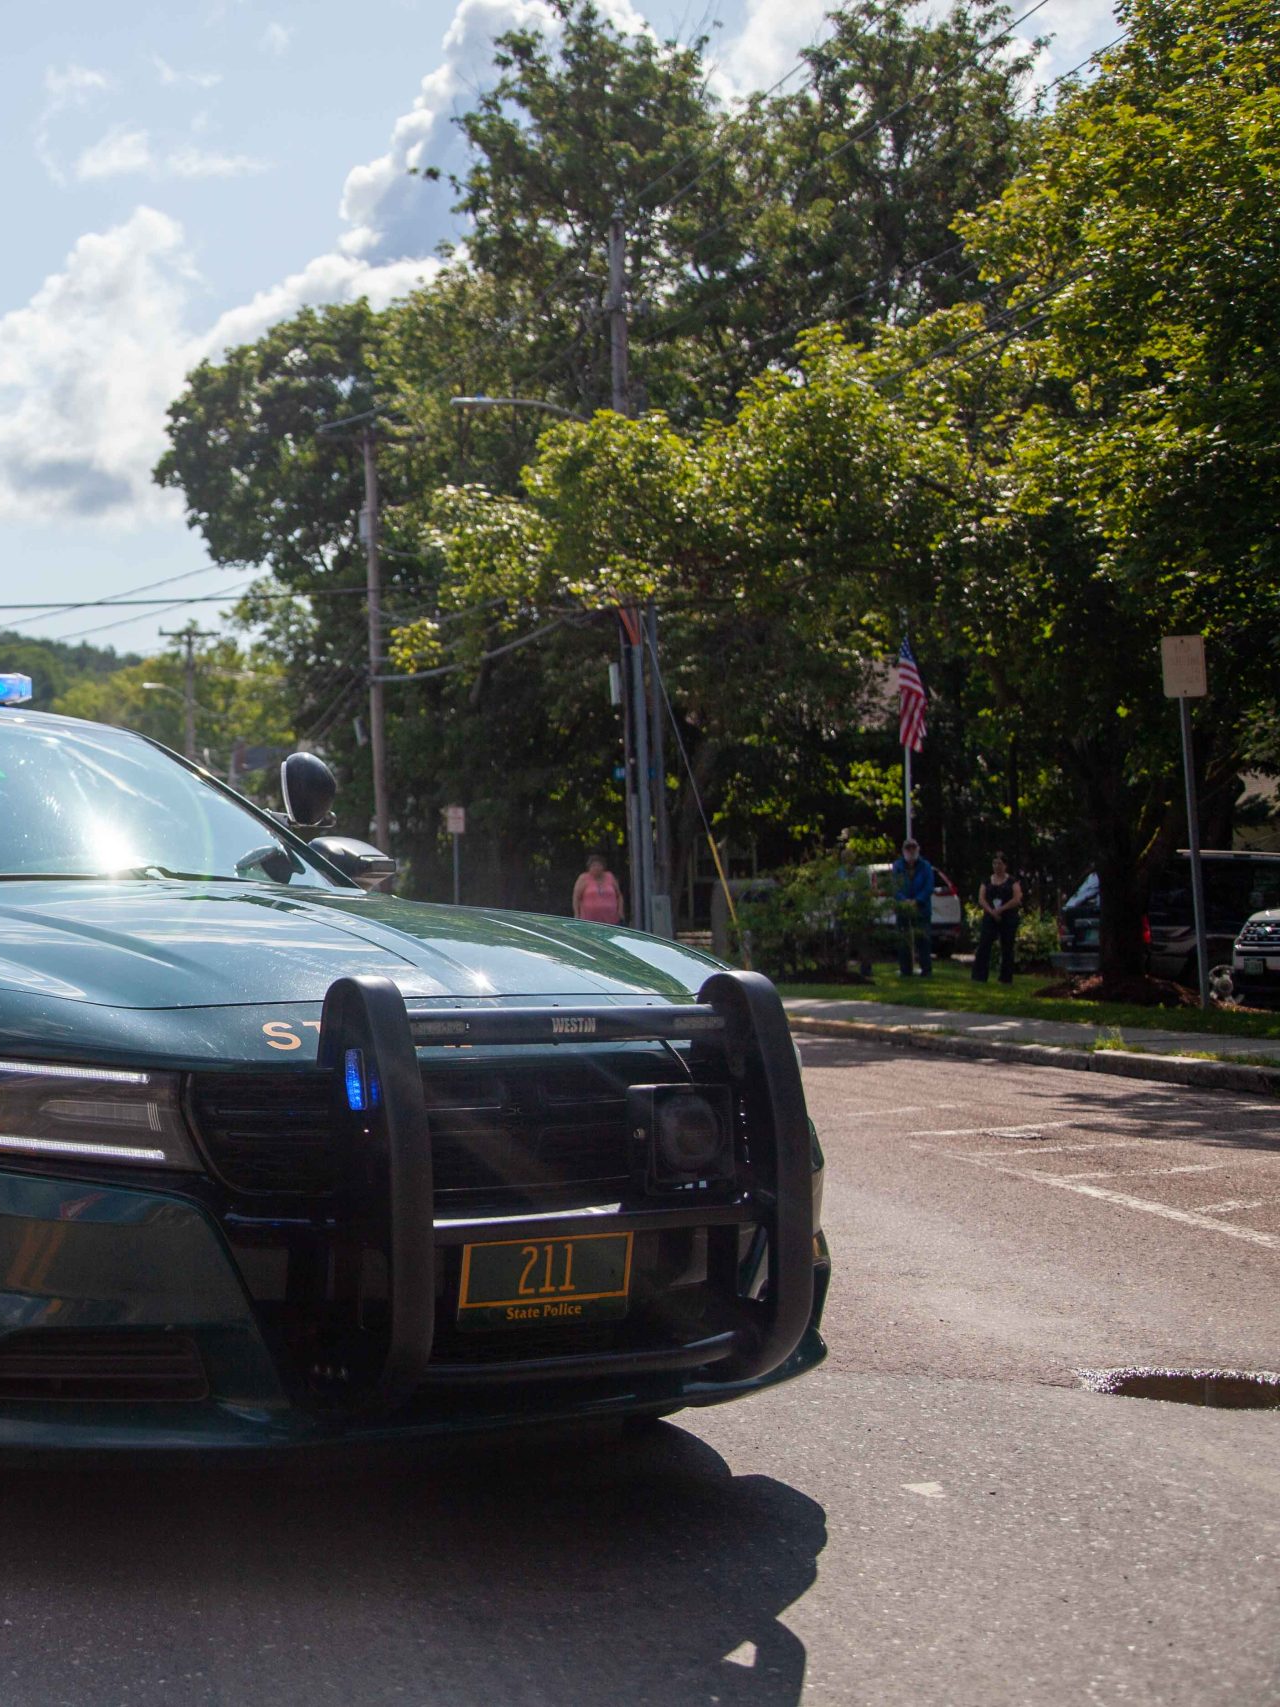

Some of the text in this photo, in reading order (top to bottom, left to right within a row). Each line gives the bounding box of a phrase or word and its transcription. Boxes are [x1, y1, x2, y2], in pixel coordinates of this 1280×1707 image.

[518, 1243, 576, 1294] 211
[506, 1303, 583, 1320] State Police
